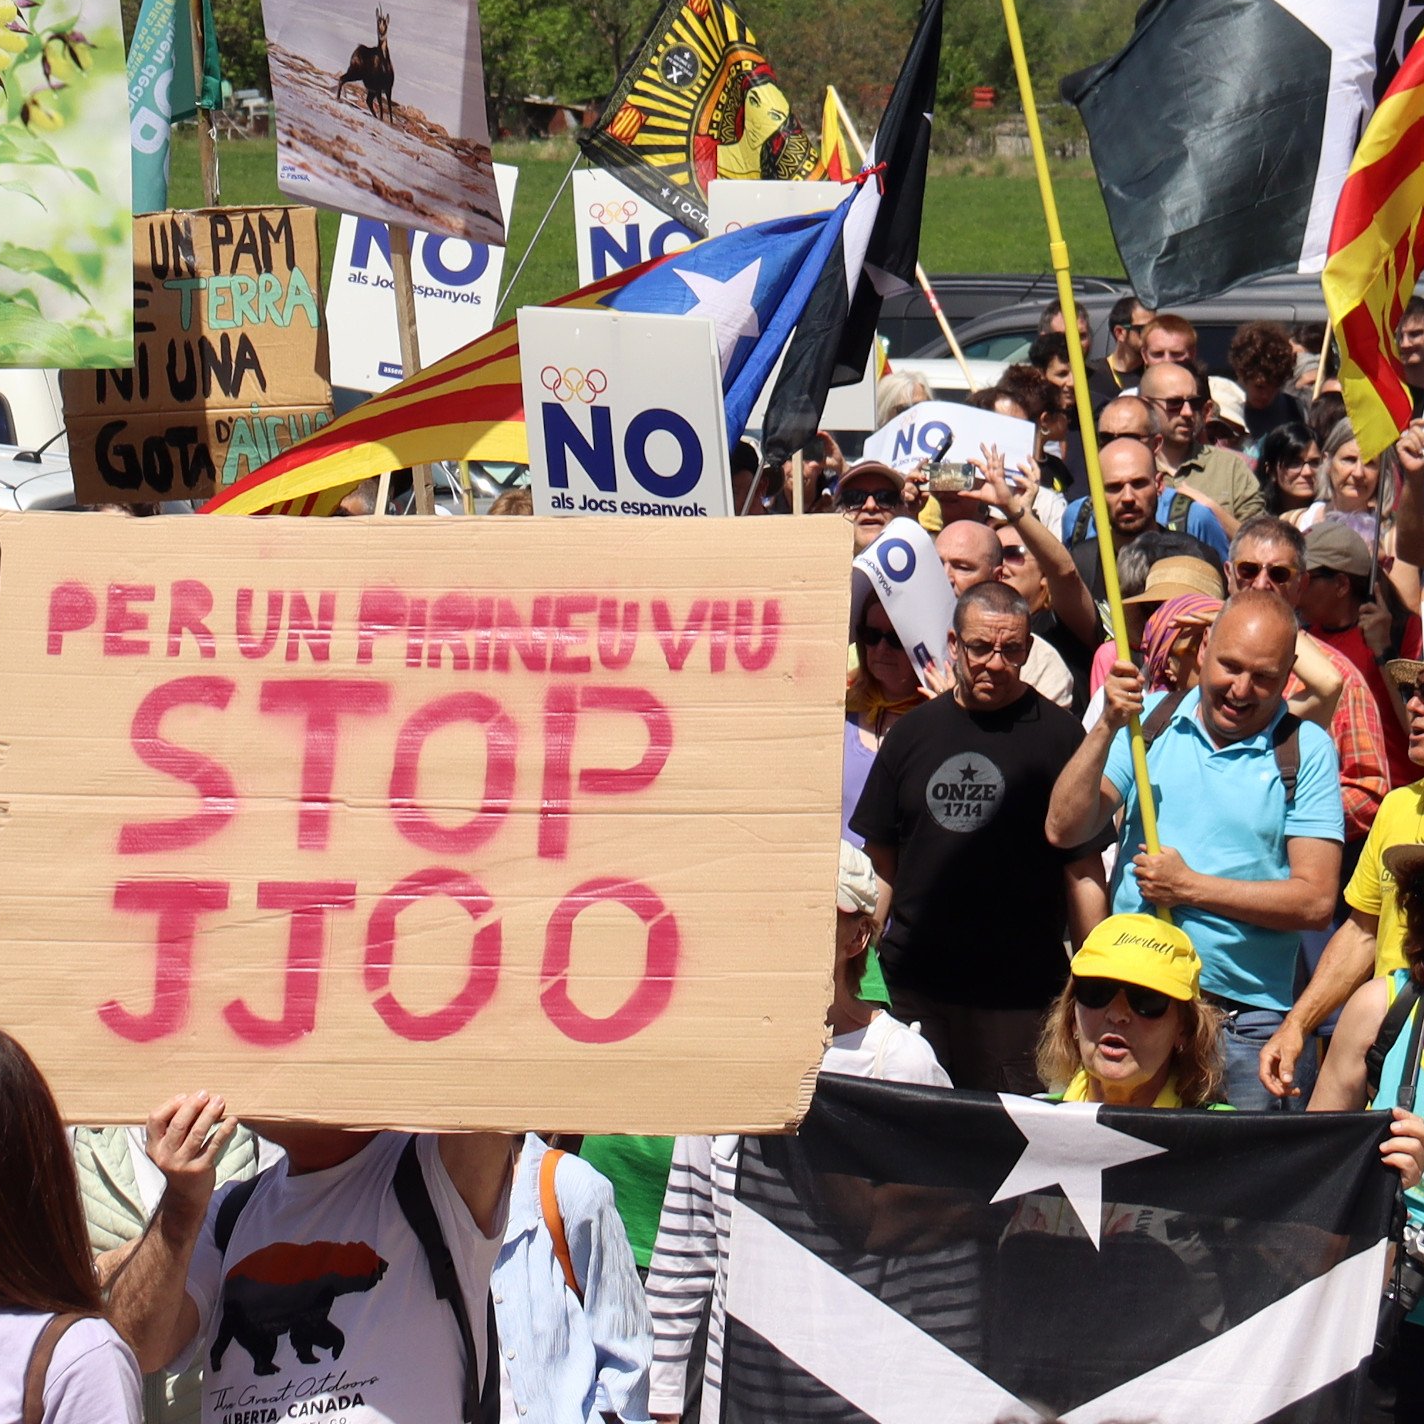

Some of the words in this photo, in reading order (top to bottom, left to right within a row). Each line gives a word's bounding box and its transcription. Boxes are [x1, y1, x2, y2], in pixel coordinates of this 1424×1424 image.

[149, 211, 196, 280] UN
[210, 209, 296, 275] PAM
[350, 217, 490, 287] NO
[162, 266, 321, 331] TERRA
[348, 272, 368, 284] als
[371, 275, 394, 290] Joc
[95, 342, 149, 405] NI
[166, 332, 267, 403] UNA
[542, 402, 703, 498] NO
[892, 421, 953, 462] NO
[551, 492, 574, 510] als
[578, 494, 617, 514] Jocs
[621, 501, 707, 516] espanyols
[876, 537, 916, 583] O
[47, 580, 216, 659] PER
[236, 588, 335, 662] UN
[355, 592, 639, 673] PIRINEU
[650, 598, 780, 673] VIU
[117, 676, 673, 860] STOP
[932, 783, 997, 802] ONZE
[944, 802, 982, 817] 1714
[97, 866, 682, 1049] JJOO
[237, 1379, 295, 1405] Great
[295, 1370, 379, 1398] Outdoors
[287, 1393, 365, 1419] CANADA
